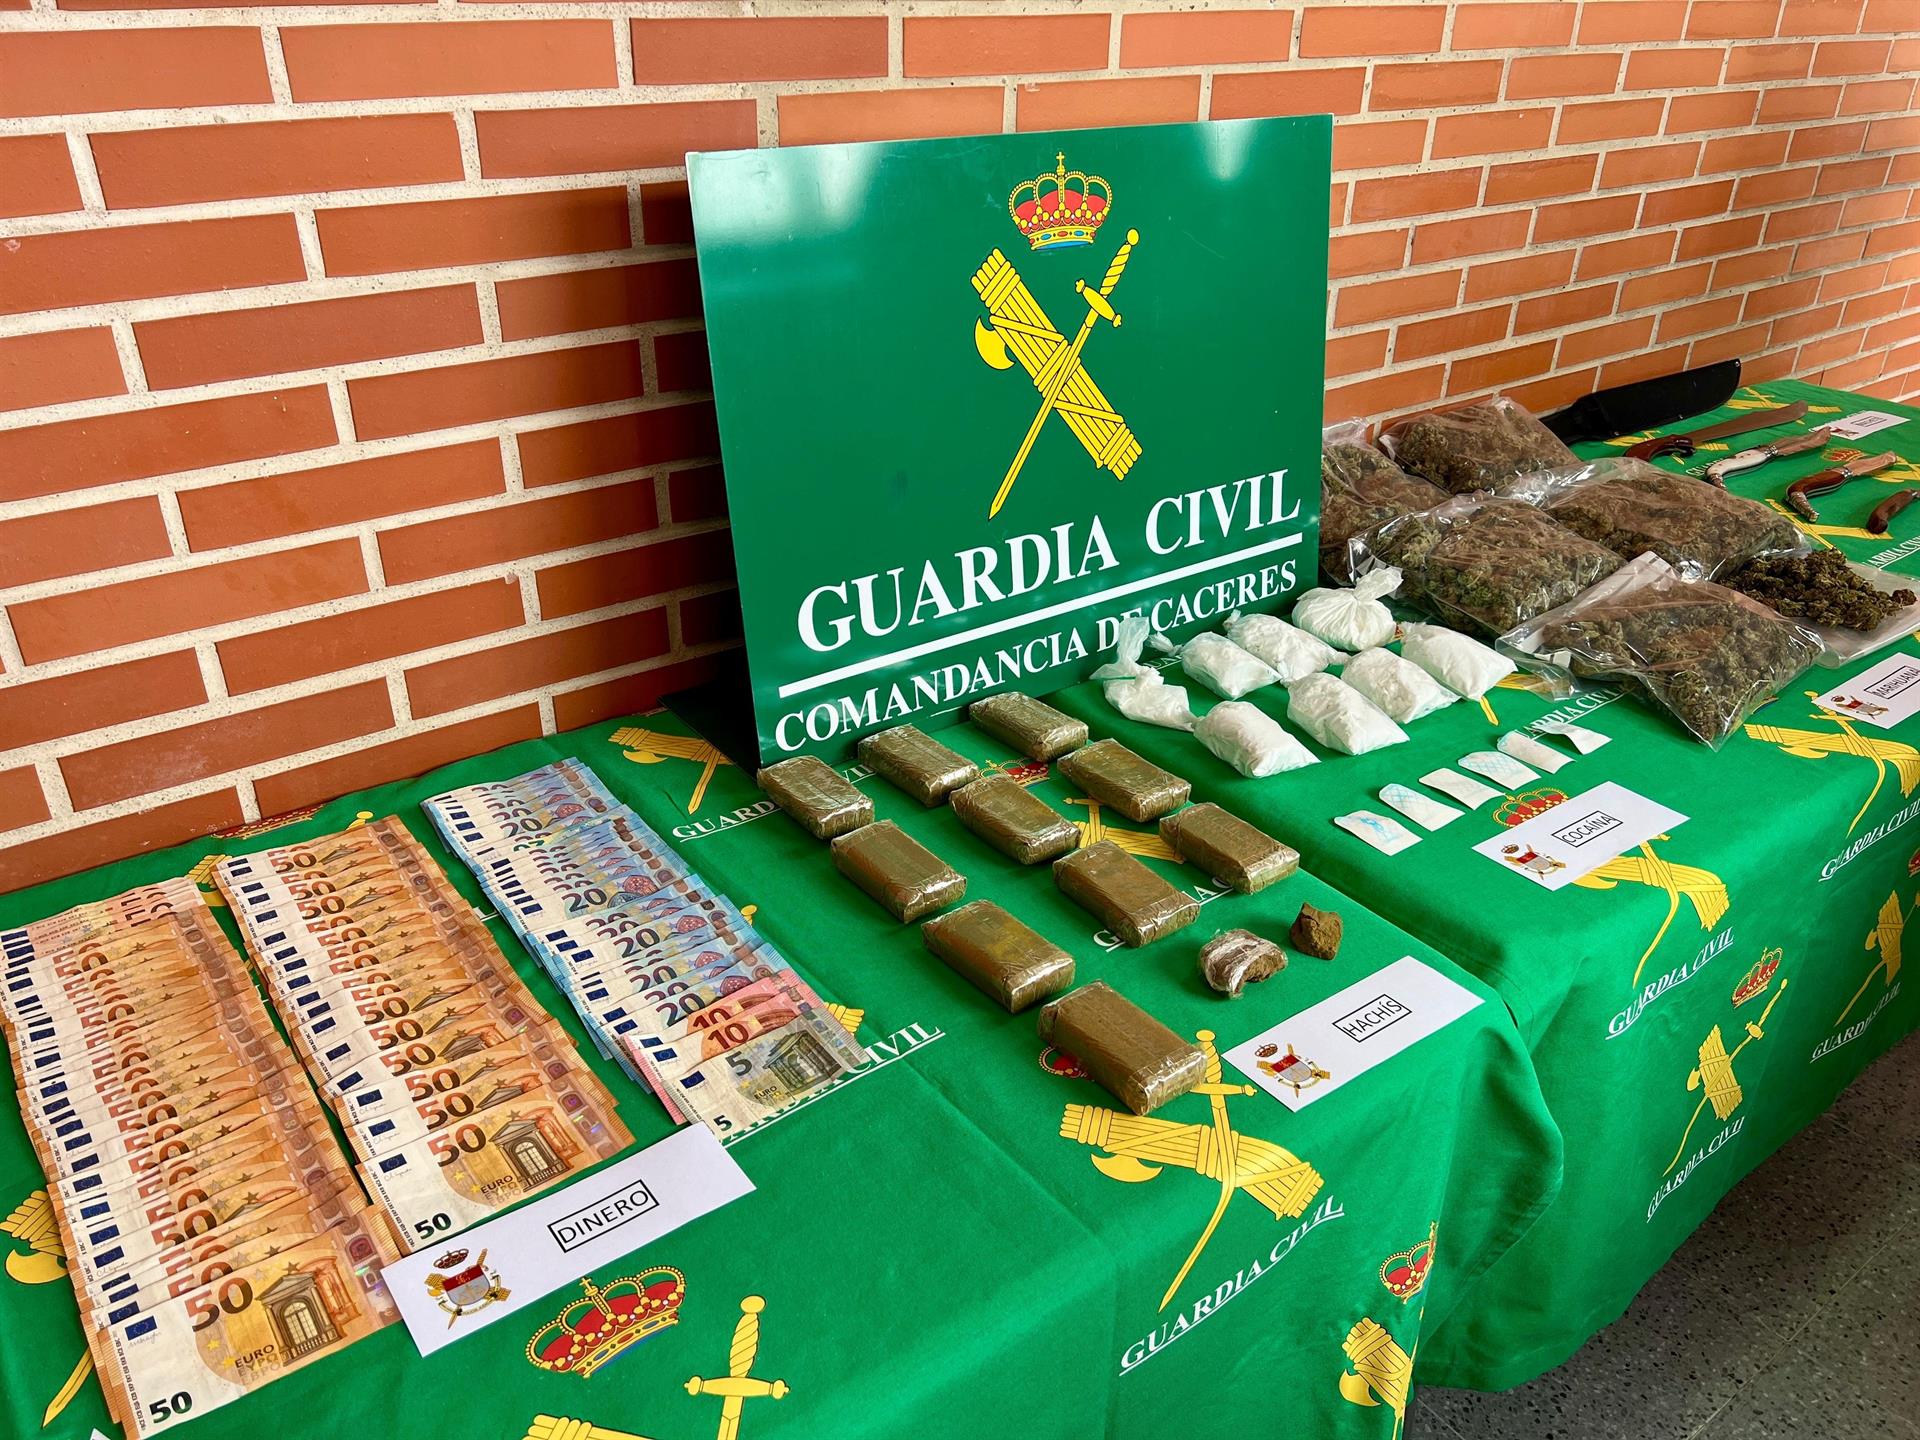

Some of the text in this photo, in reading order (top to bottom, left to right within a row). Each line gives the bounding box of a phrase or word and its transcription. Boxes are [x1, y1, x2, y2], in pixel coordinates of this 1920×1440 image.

[798, 468, 1301, 652] GUARDIA CIVIL
[775, 628, 1089, 752] COMANDANCIA
[1151, 560, 1297, 632] CACERES
[500, 817, 543, 837] 20
[672, 801, 775, 838] GUARD
[1561, 814, 1616, 844] COCAÍNA
[270, 852, 317, 874] 50
[296, 895, 346, 920] 50
[562, 887, 608, 913] 20
[613, 928, 661, 959] 20
[1608, 926, 1734, 1034] GUARDIA CIVIL
[356, 996, 410, 1025] 50
[656, 992, 706, 1027] 20
[1343, 1000, 1402, 1037] HACHÍS
[368, 1019, 424, 1050] 50
[707, 1022, 750, 1050] 10
[380, 1043, 436, 1077] 50
[726, 1051, 753, 1077] 5
[404, 1068, 461, 1102] 50
[417, 1092, 474, 1130] 50
[713, 1115, 732, 1132] 5
[426, 1123, 487, 1167] 50
[481, 1175, 513, 1194] EURO
[413, 1212, 452, 1240] 50
[557, 1189, 650, 1245] DINERO
[1120, 1195, 1344, 1370] GUARDIA CIVIL
[185, 1277, 253, 1332] 50
[235, 1345, 274, 1368] EURO
[149, 1391, 192, 1423] 50
